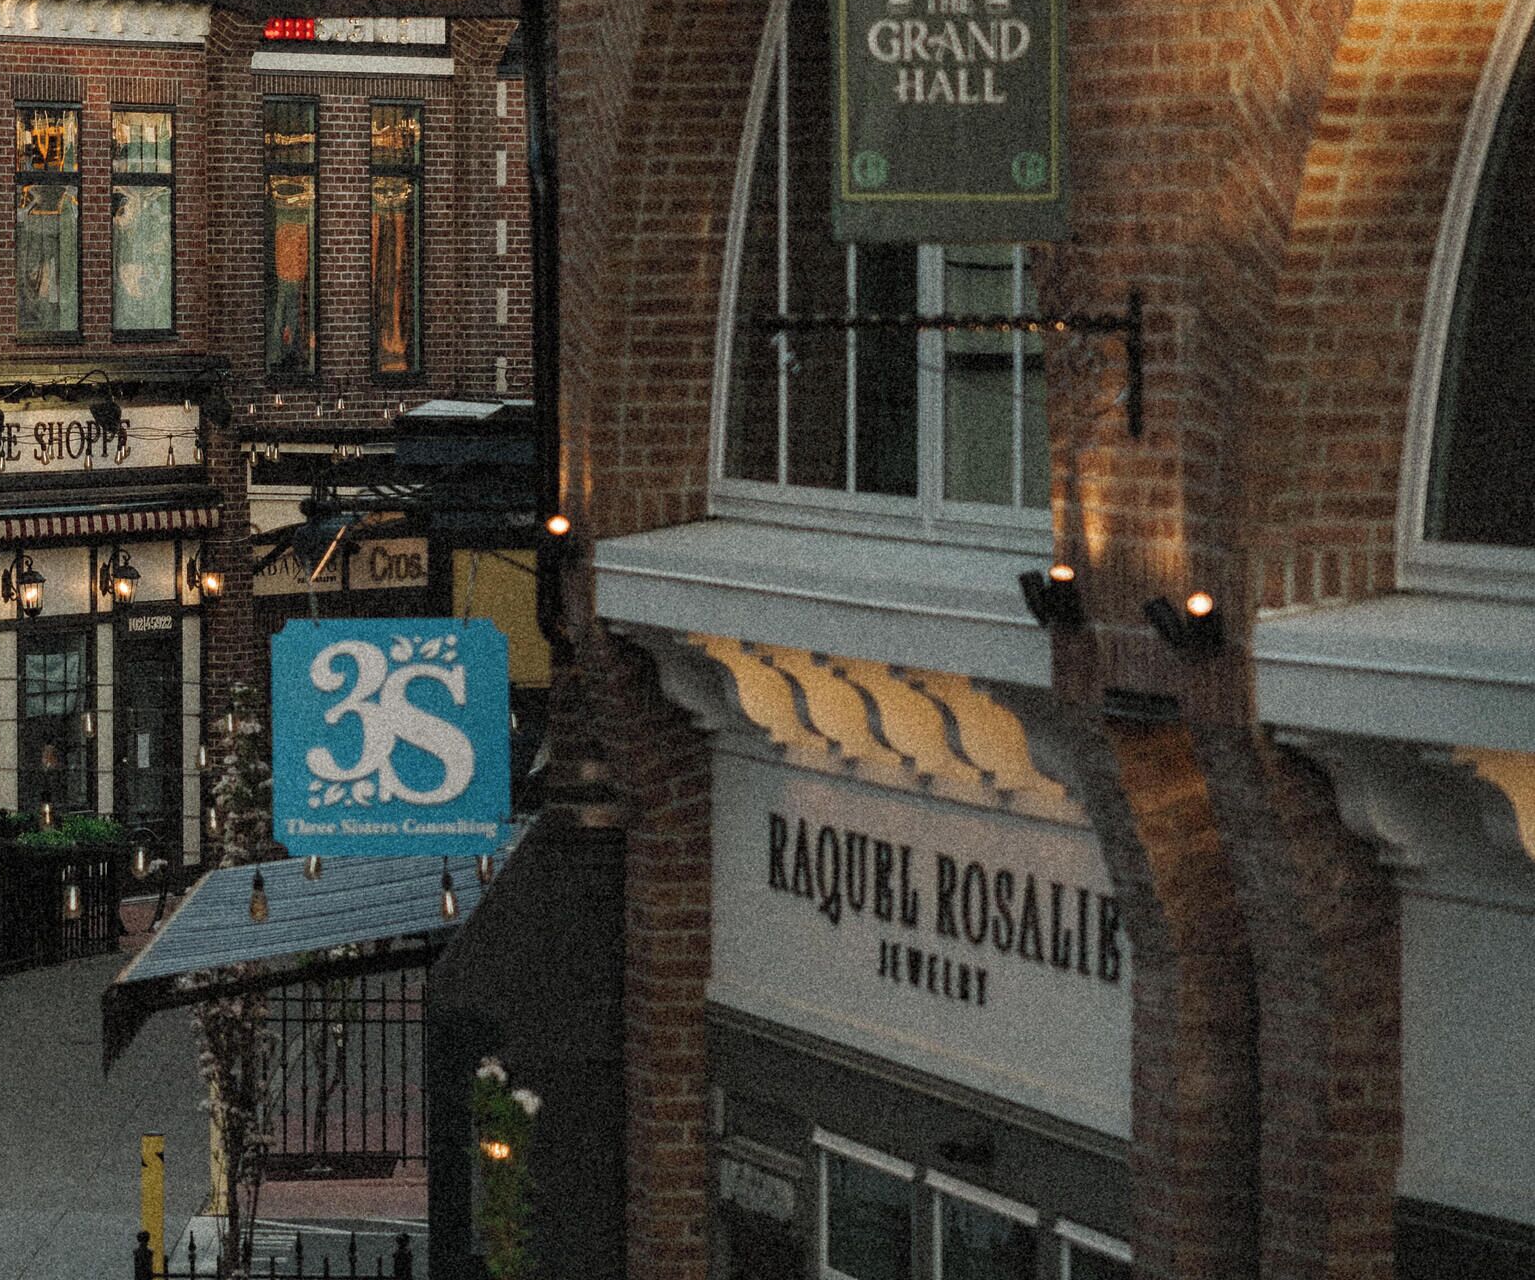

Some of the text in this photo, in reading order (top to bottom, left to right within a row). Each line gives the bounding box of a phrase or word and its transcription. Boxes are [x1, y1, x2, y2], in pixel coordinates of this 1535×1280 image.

[867, 18, 1031, 63] GRAND
[895, 68, 1008, 104] HALL
[306, 639, 476, 807] 3S
[287, 819, 337, 835] Three
[341, 819, 398, 835] Sisters
[769, 812, 1119, 983] RAQUEL ROSALIE
[878, 938, 986, 1007] JEWELRY
